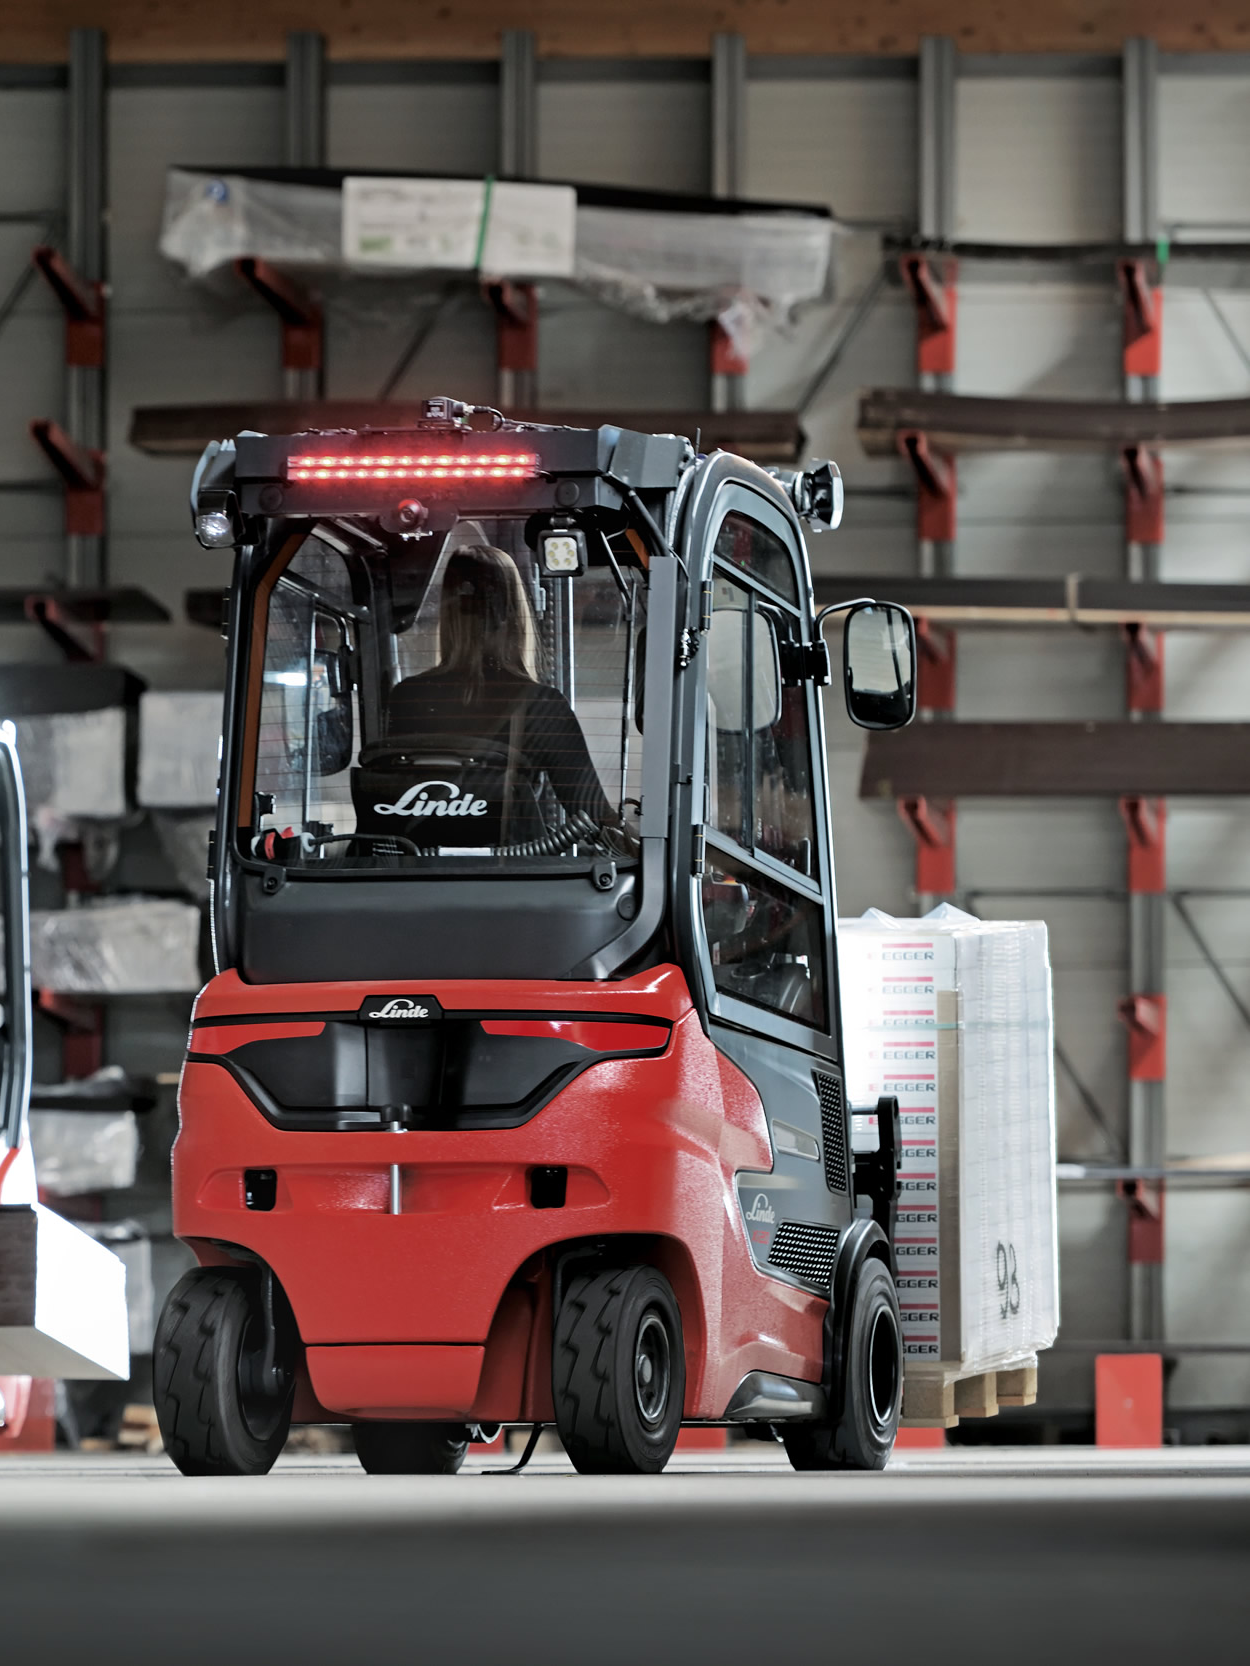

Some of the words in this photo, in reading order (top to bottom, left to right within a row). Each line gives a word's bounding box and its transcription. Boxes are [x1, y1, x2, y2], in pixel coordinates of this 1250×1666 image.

[374, 780, 488, 817] Linde
[882, 951, 934, 961] EGGER
[882, 985, 935, 994] EGGER
[369, 998, 429, 1019] Linde
[883, 1050, 936, 1060] EGGER
[883, 1082, 936, 1092] EGGER
[745, 1193, 775, 1224] Linde
[897, 1213, 938, 1223] GGER
[896, 1246, 938, 1256] GGER
[896, 1279, 939, 1289] GGER
[900, 1312, 940, 1322] GGER
